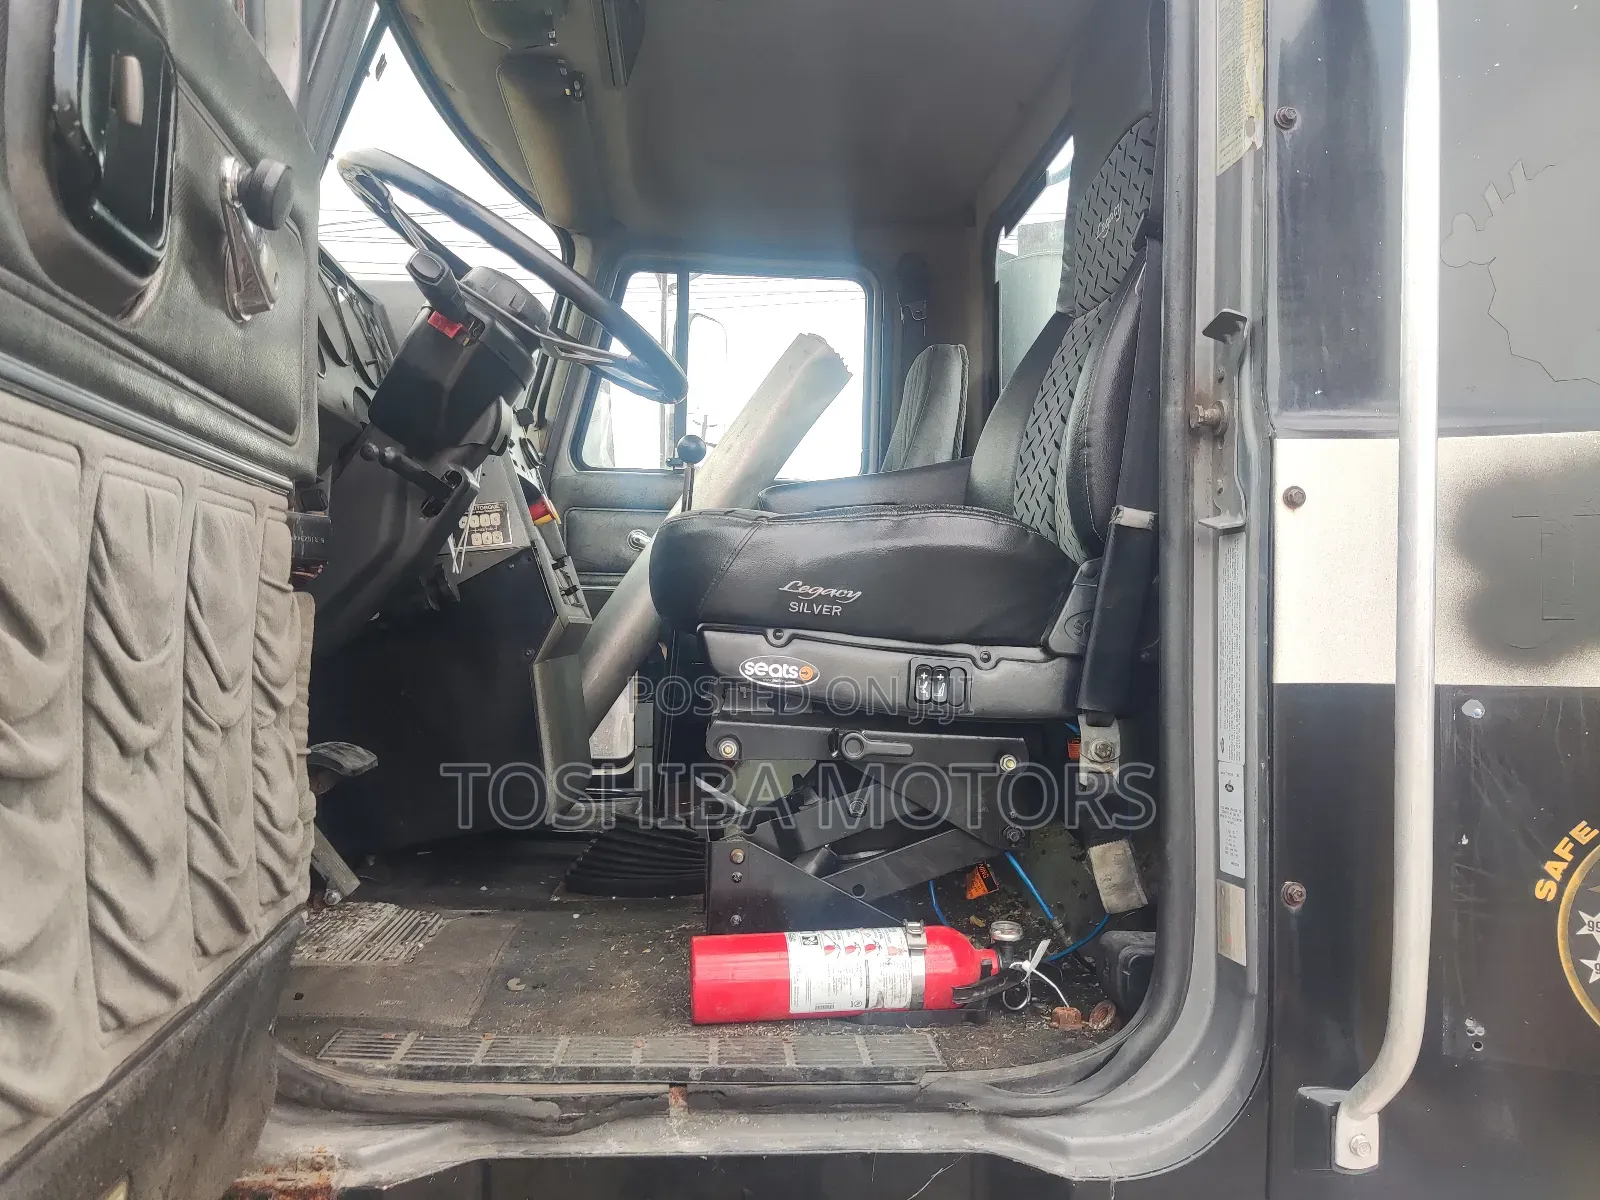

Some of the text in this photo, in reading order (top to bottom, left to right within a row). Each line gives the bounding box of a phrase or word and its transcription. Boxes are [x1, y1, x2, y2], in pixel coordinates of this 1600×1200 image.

[1095, 200, 1123, 240] Legacy
[778, 580, 863, 604] Legacy
[788, 601, 842, 617] SILVER
[744, 661, 799, 679] seats
[1534, 820, 1600, 902] SAFE
